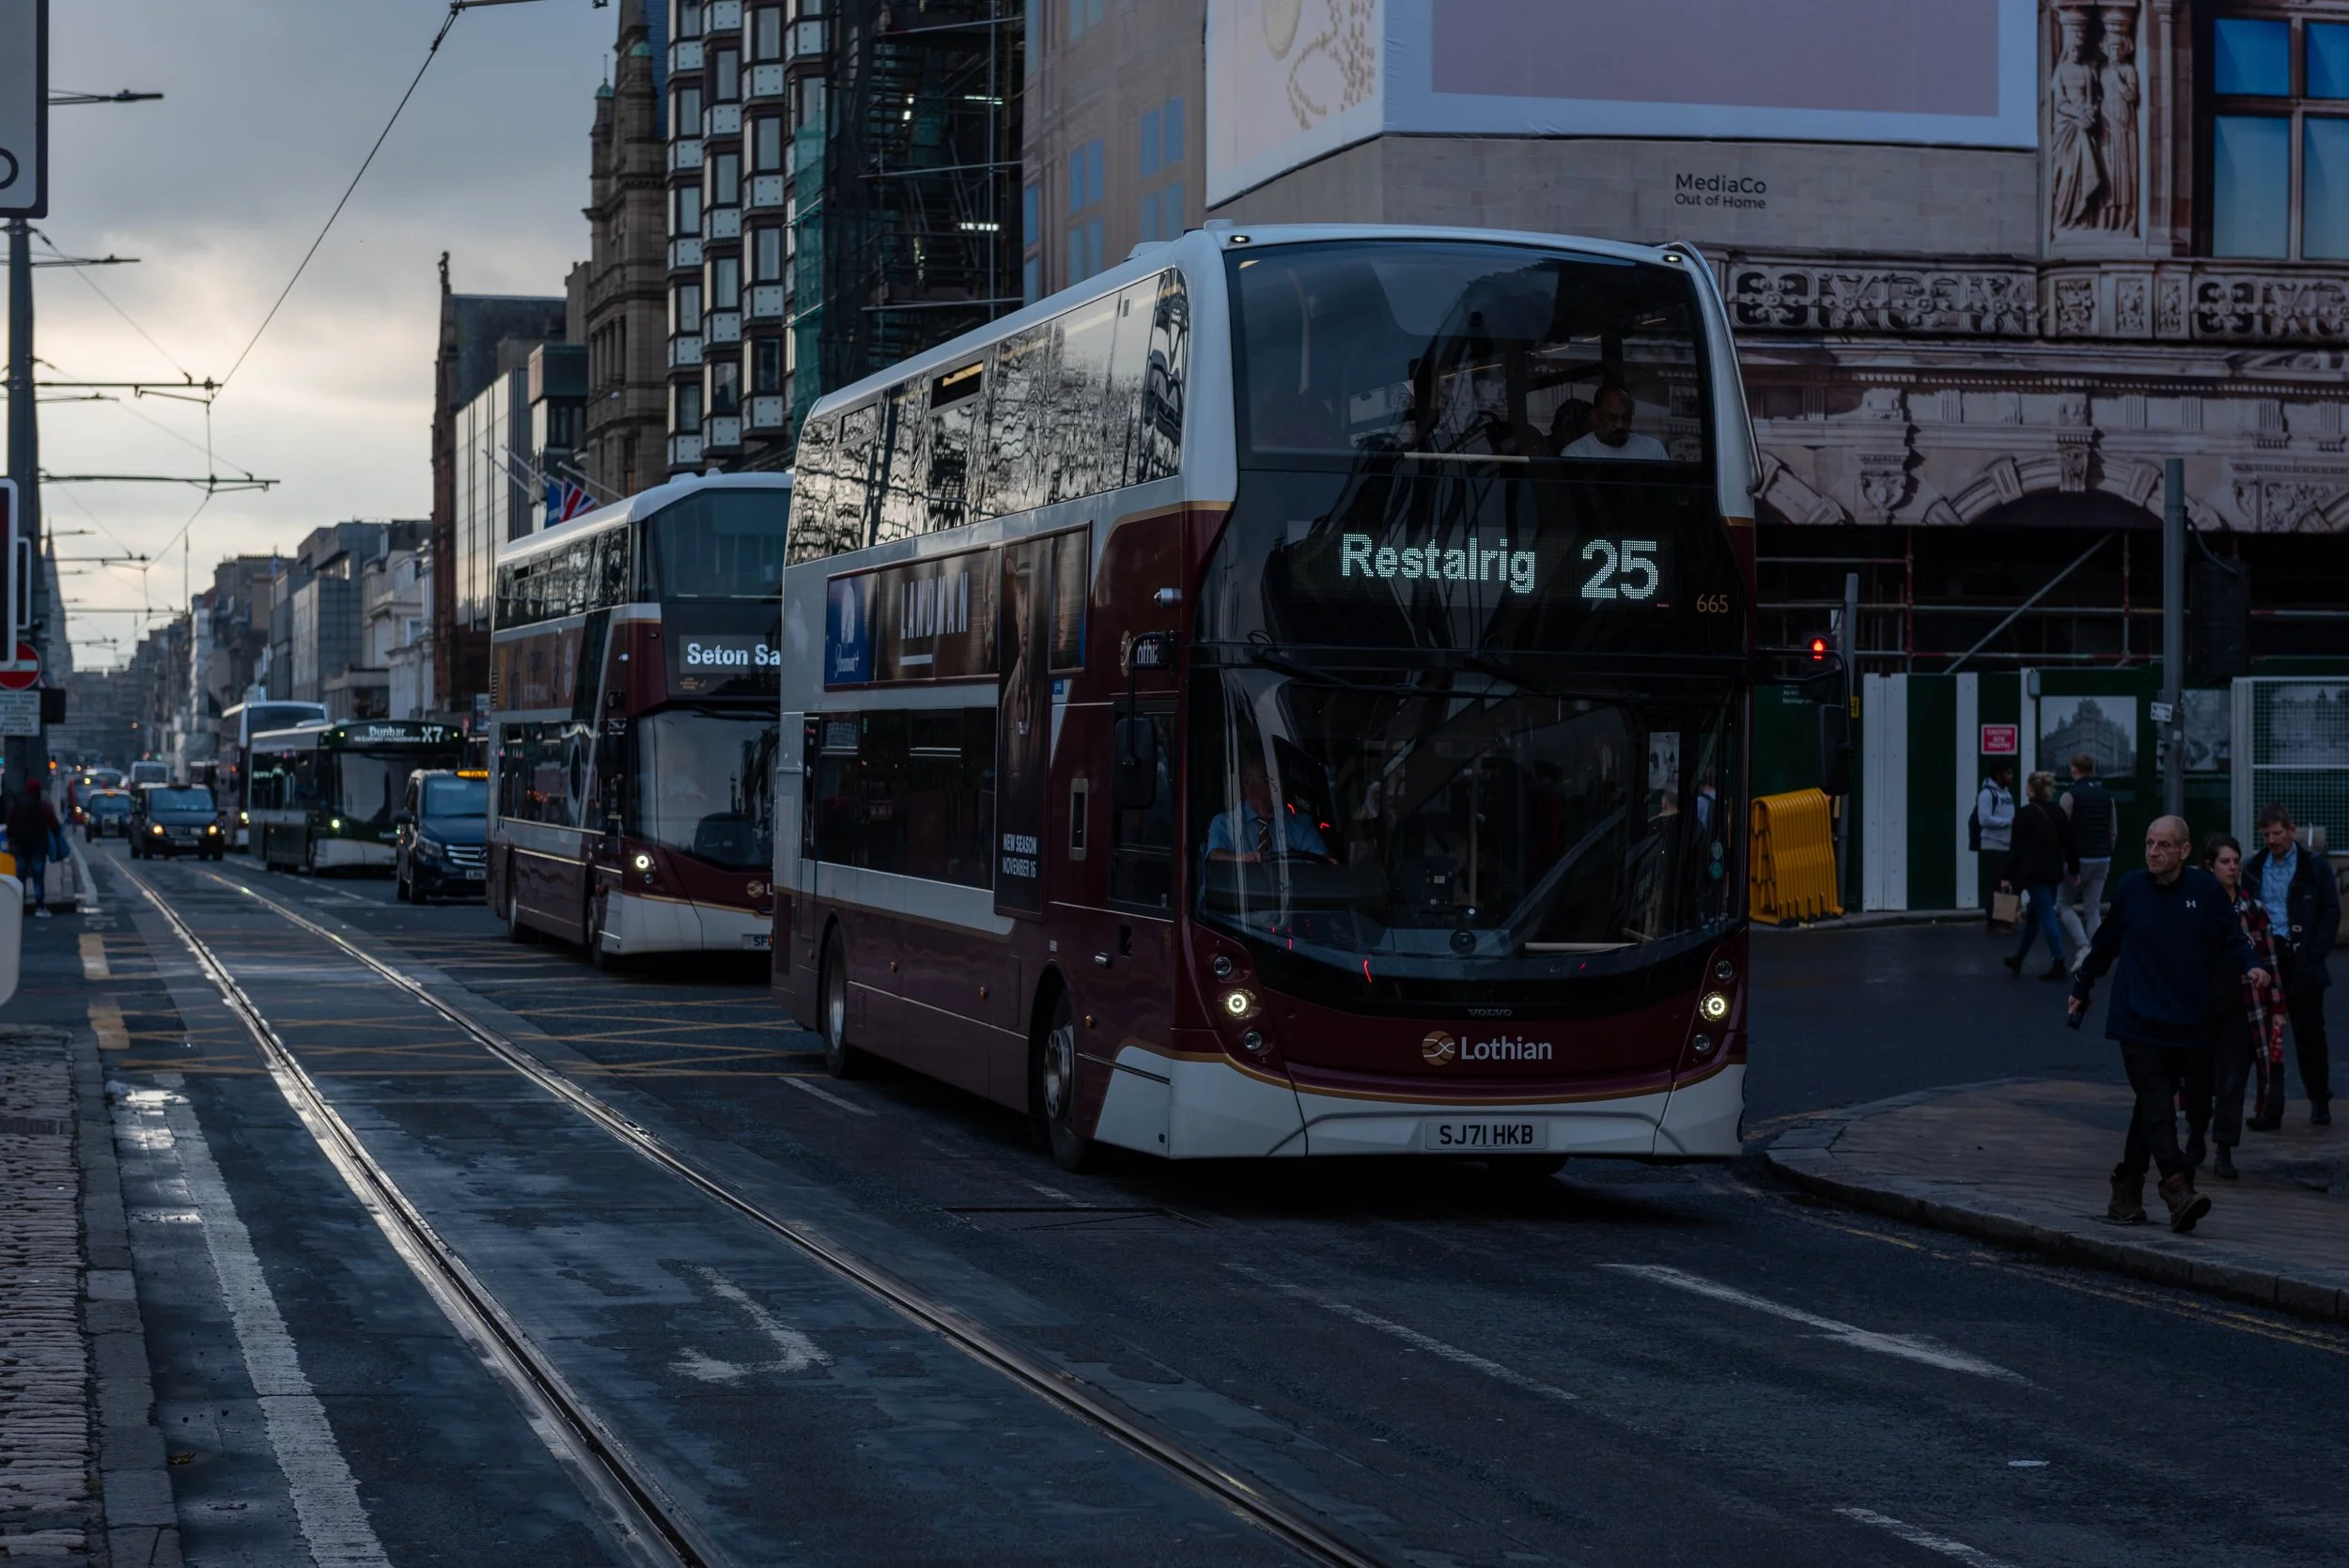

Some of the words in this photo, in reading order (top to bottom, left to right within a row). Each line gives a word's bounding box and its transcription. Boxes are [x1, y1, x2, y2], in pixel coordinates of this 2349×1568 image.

[1675, 173, 1766, 194] MediaCo
[1674, 193, 1702, 206] Out
[1704, 194, 1720, 207] of
[1722, 195, 1766, 210] Home
[1341, 533, 1536, 595] Restalrig
[1579, 538, 1659, 600] 25
[899, 571, 969, 641] LANDMAN
[1696, 593, 1729, 613] 665
[687, 643, 749, 665] Seton
[367, 724, 407, 737] Dunbar
[420, 725, 444, 744] X7
[1003, 832, 1016, 852] NEW
[1016, 833, 1037, 855] SEASON
[1002, 856, 1030, 877] NOVEMBER
[1030, 859, 1037, 879] 16
[1466, 1008, 1514, 1017] VOLVO
[1460, 1035, 1553, 1061] Lothian
[1439, 1125, 1487, 1145] SJ71
[1493, 1125, 1533, 1145] HKB
